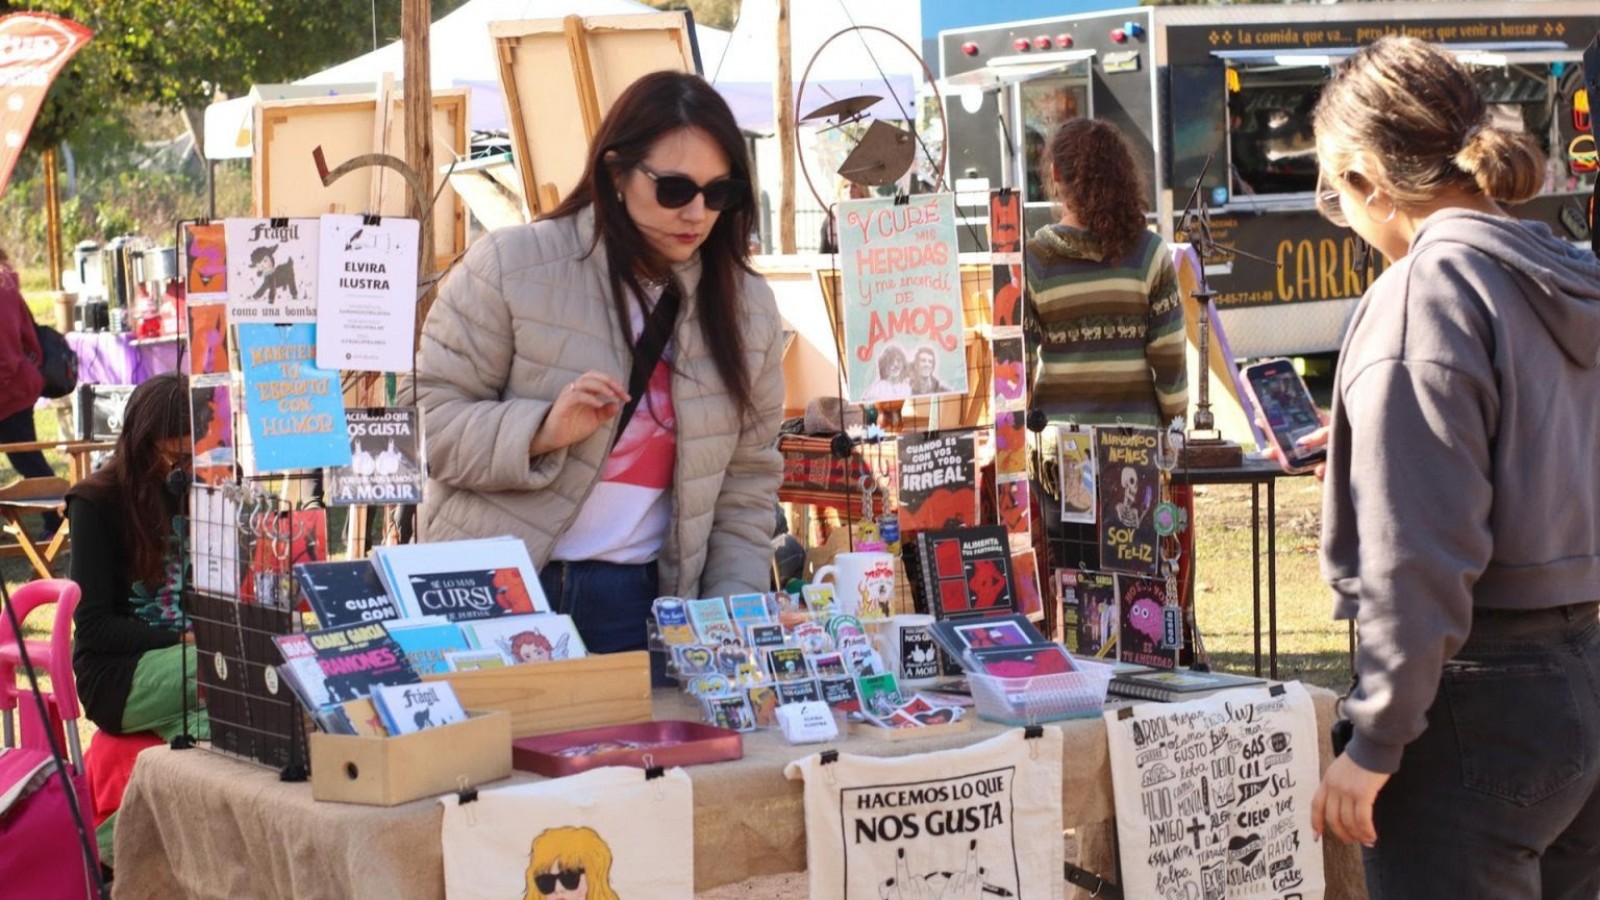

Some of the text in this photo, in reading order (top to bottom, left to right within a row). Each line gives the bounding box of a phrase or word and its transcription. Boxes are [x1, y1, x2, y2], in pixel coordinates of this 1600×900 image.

[1255, 28, 1299, 44] comida
[1303, 31, 1323, 47] que
[1356, 26, 1383, 43] pero
[1437, 26, 1457, 42] que
[1460, 22, 1488, 37] venir
[1490, 25, 1497, 37] a
[1501, 22, 1538, 37] buscar
[848, 199, 940, 244] Y CURÉ
[915, 231, 936, 242] MIS
[344, 261, 386, 274] ELVIRA
[855, 242, 949, 276] HERIDAS
[1276, 236, 1375, 301] CARR
[339, 277, 390, 290] ILUSTRA
[875, 279, 896, 294] me
[900, 272, 952, 293] encendí
[895, 291, 914, 305] DE
[231, 305, 317, 317] como una bomba
[857, 303, 958, 362] AMOR
[261, 411, 334, 438] HUMOR
[347, 423, 411, 437] OS GUSTA
[905, 437, 957, 454] CUANDO ES
[912, 447, 951, 463] CON VOS
[1108, 446, 1149, 466] MEMES
[902, 455, 962, 473] SIENTO TODO
[903, 465, 966, 491] IRREAL
[341, 484, 414, 500] A MORIR
[1108, 527, 1136, 546] SOY
[1117, 545, 1152, 562] FELIZ
[345, 594, 389, 610] CUAN
[422, 586, 495, 611] CURSI
[361, 606, 395, 621] CON
[319, 647, 397, 677] RAMONES
[1225, 701, 1263, 724] luz
[1174, 742, 1208, 763] GUSTO
[1242, 734, 1266, 760] GAS
[1239, 760, 1263, 780] CAL
[857, 776, 1004, 810] HACEMOS LO QUE
[1141, 786, 1173, 821] HIJO
[855, 800, 1003, 844] NOS GUSTA
[1149, 819, 1184, 848] AMIGO
[1237, 807, 1271, 829] CIELO
[1268, 834, 1293, 860] RAYO
